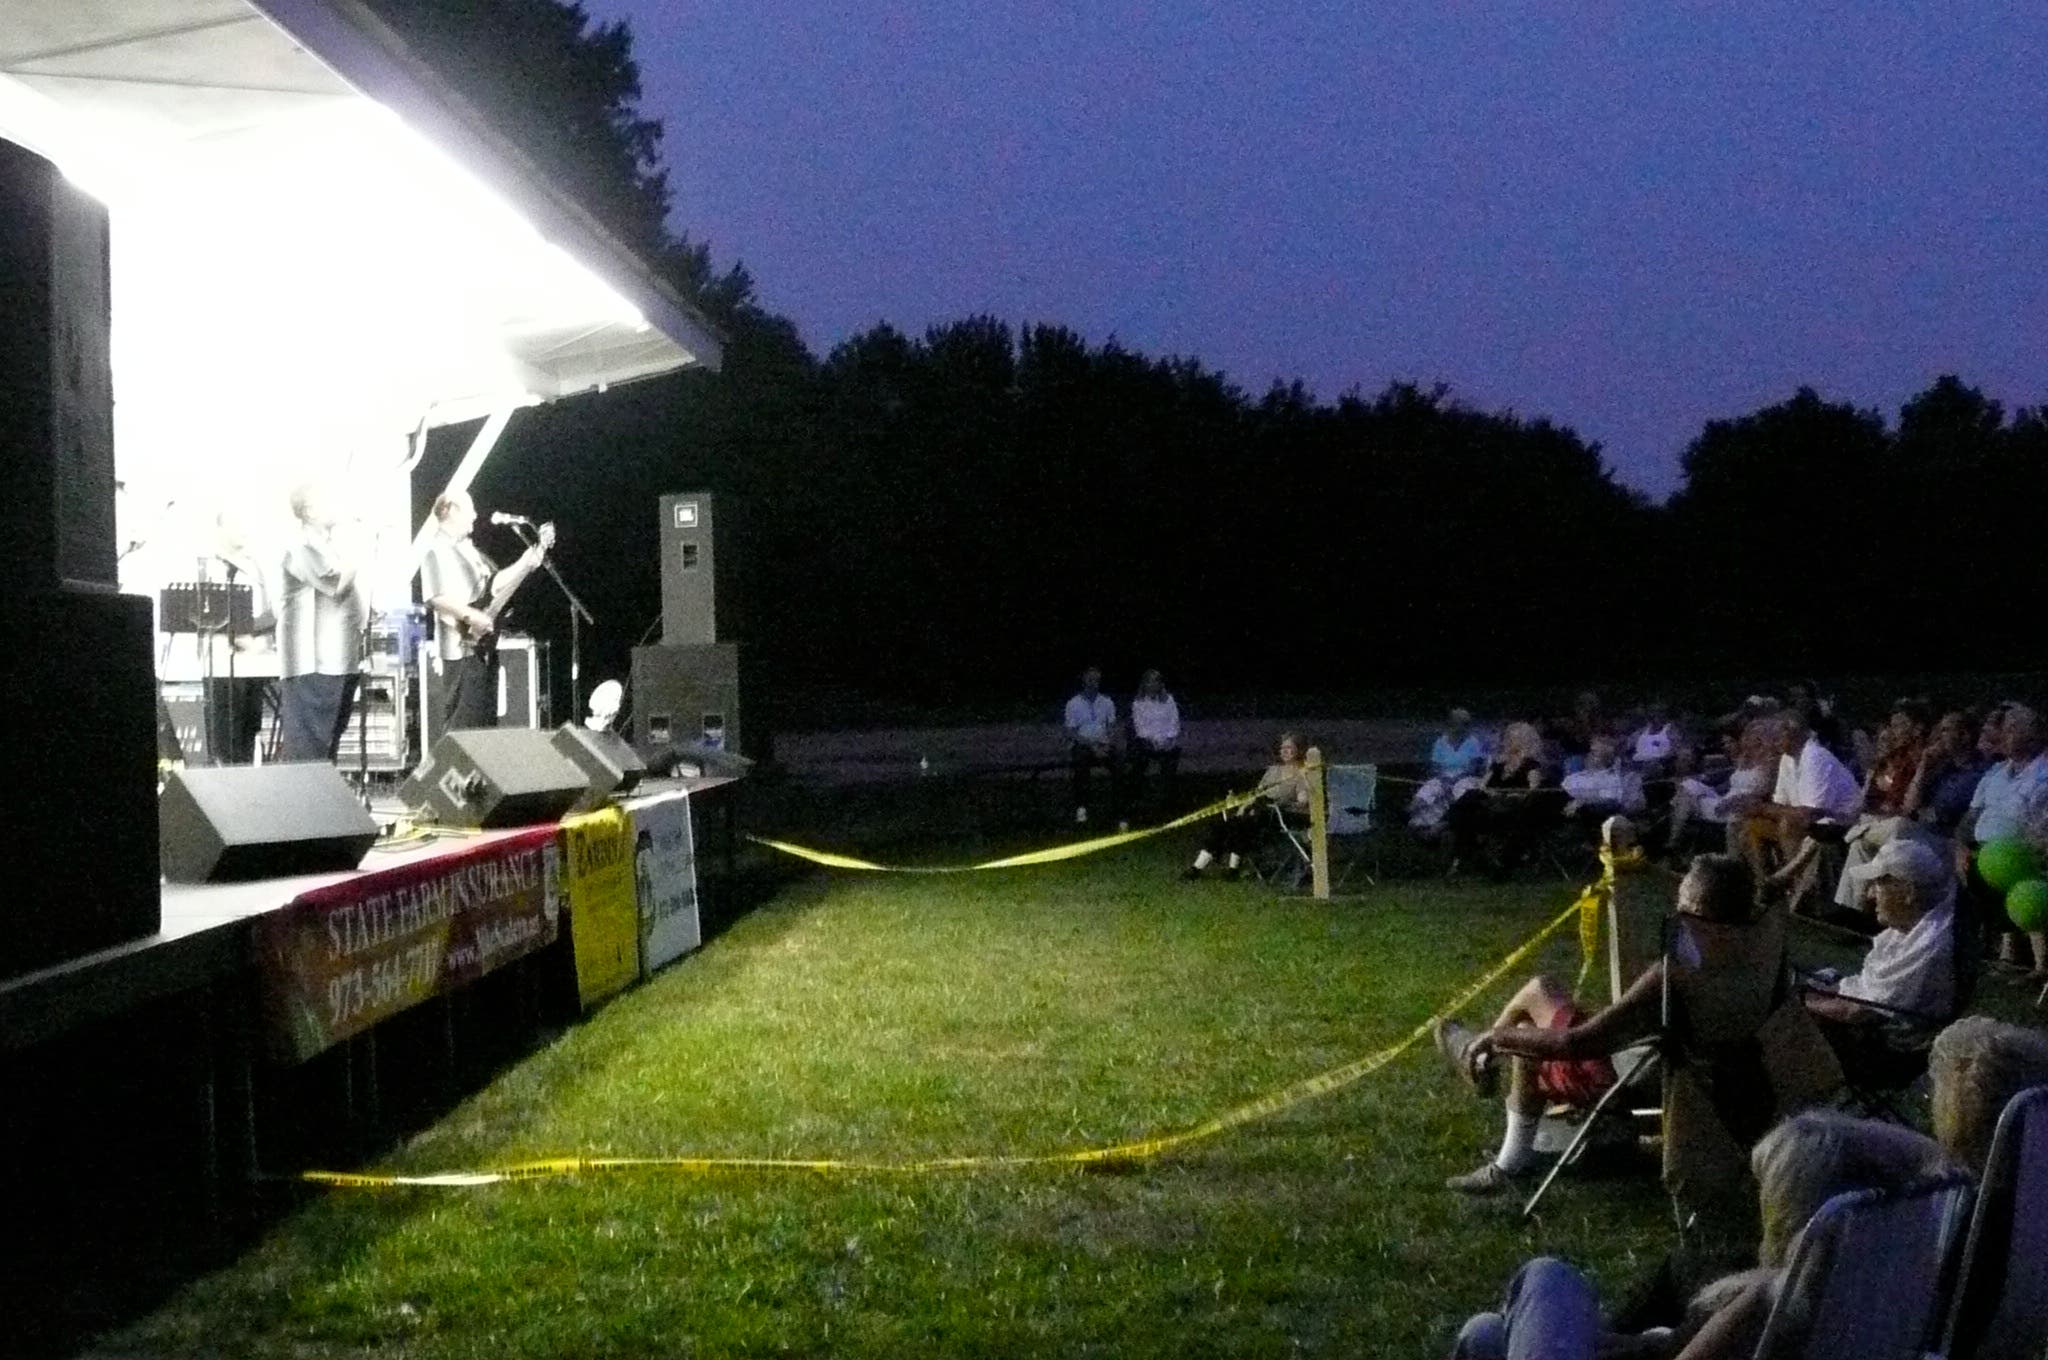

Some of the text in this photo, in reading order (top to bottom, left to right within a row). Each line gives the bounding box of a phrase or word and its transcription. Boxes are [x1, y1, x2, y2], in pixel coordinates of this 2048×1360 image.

[328, 896, 395, 959] STATE
[396, 876, 448, 935] FARM
[449, 849, 539, 916] INSURANCE
